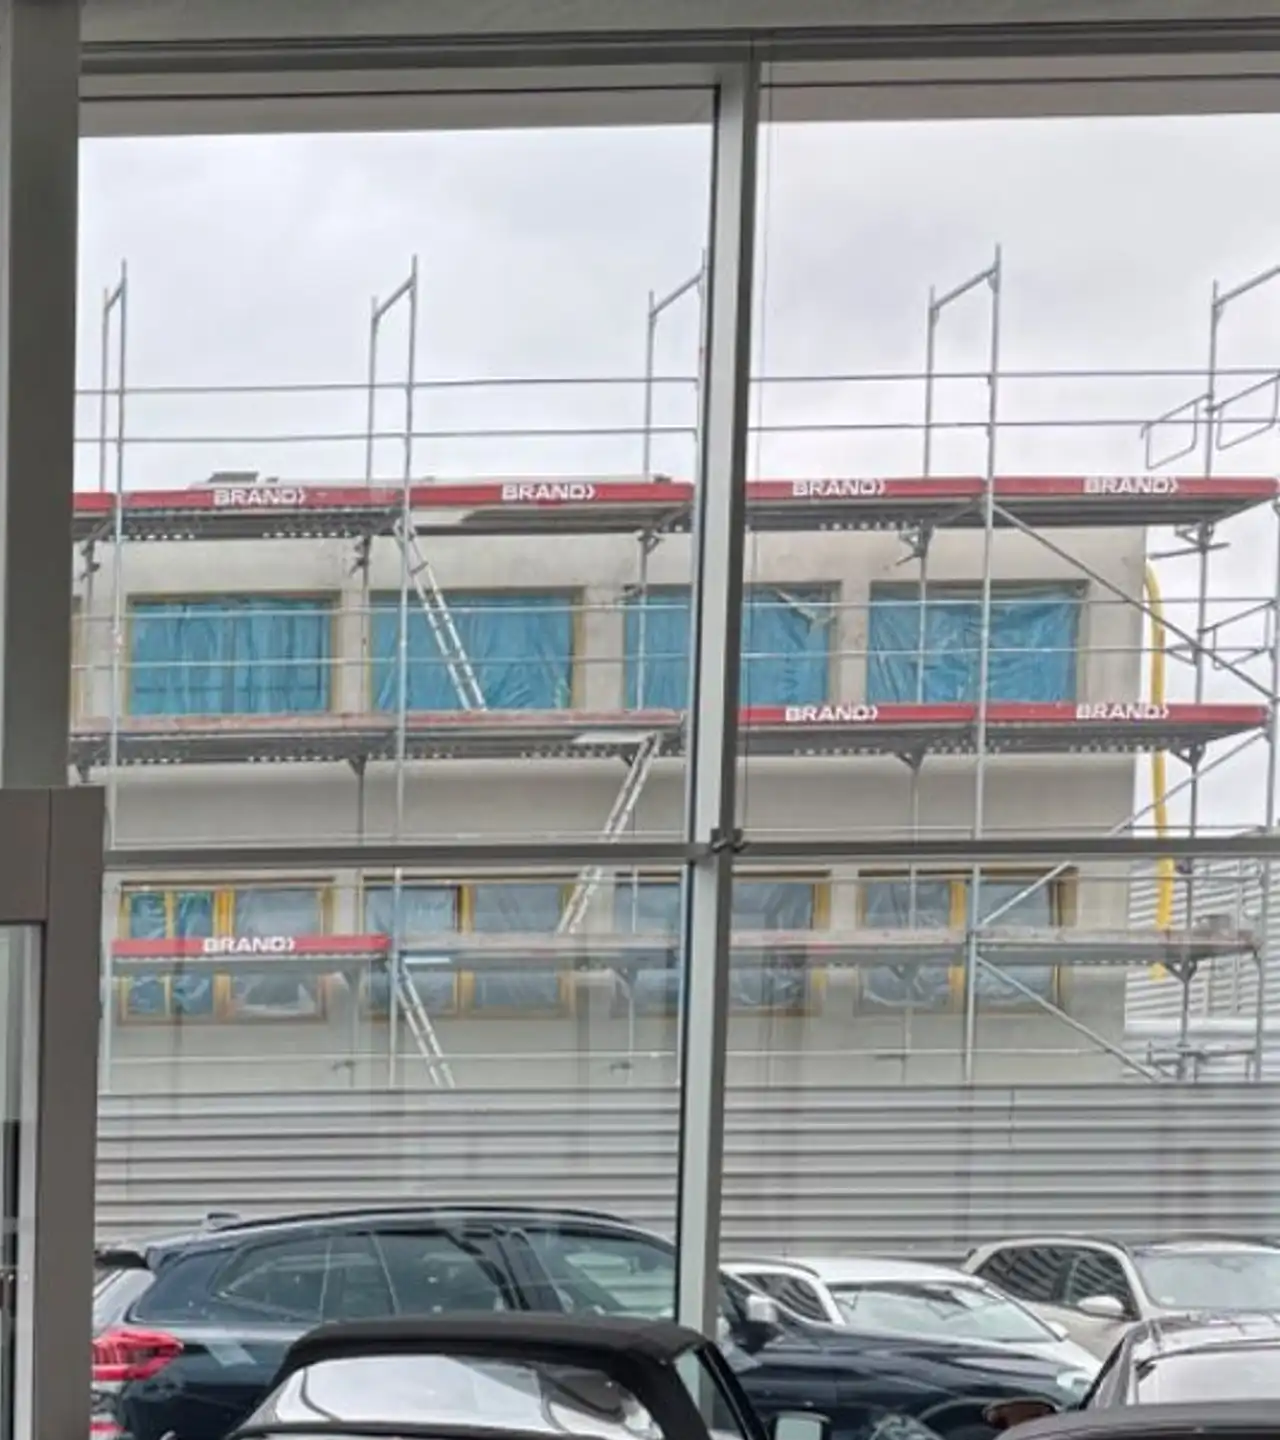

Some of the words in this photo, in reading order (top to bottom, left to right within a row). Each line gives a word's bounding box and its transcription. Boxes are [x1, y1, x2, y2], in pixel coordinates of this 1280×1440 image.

[502, 484, 589, 500] BRAND
[792, 480, 880, 496] BRAND
[1084, 477, 1172, 494] BRAND
[213, 488, 301, 505] BRAND
[785, 706, 872, 722] BRAND
[1076, 705, 1163, 720] BRAND
[204, 936, 290, 954] BRAND
